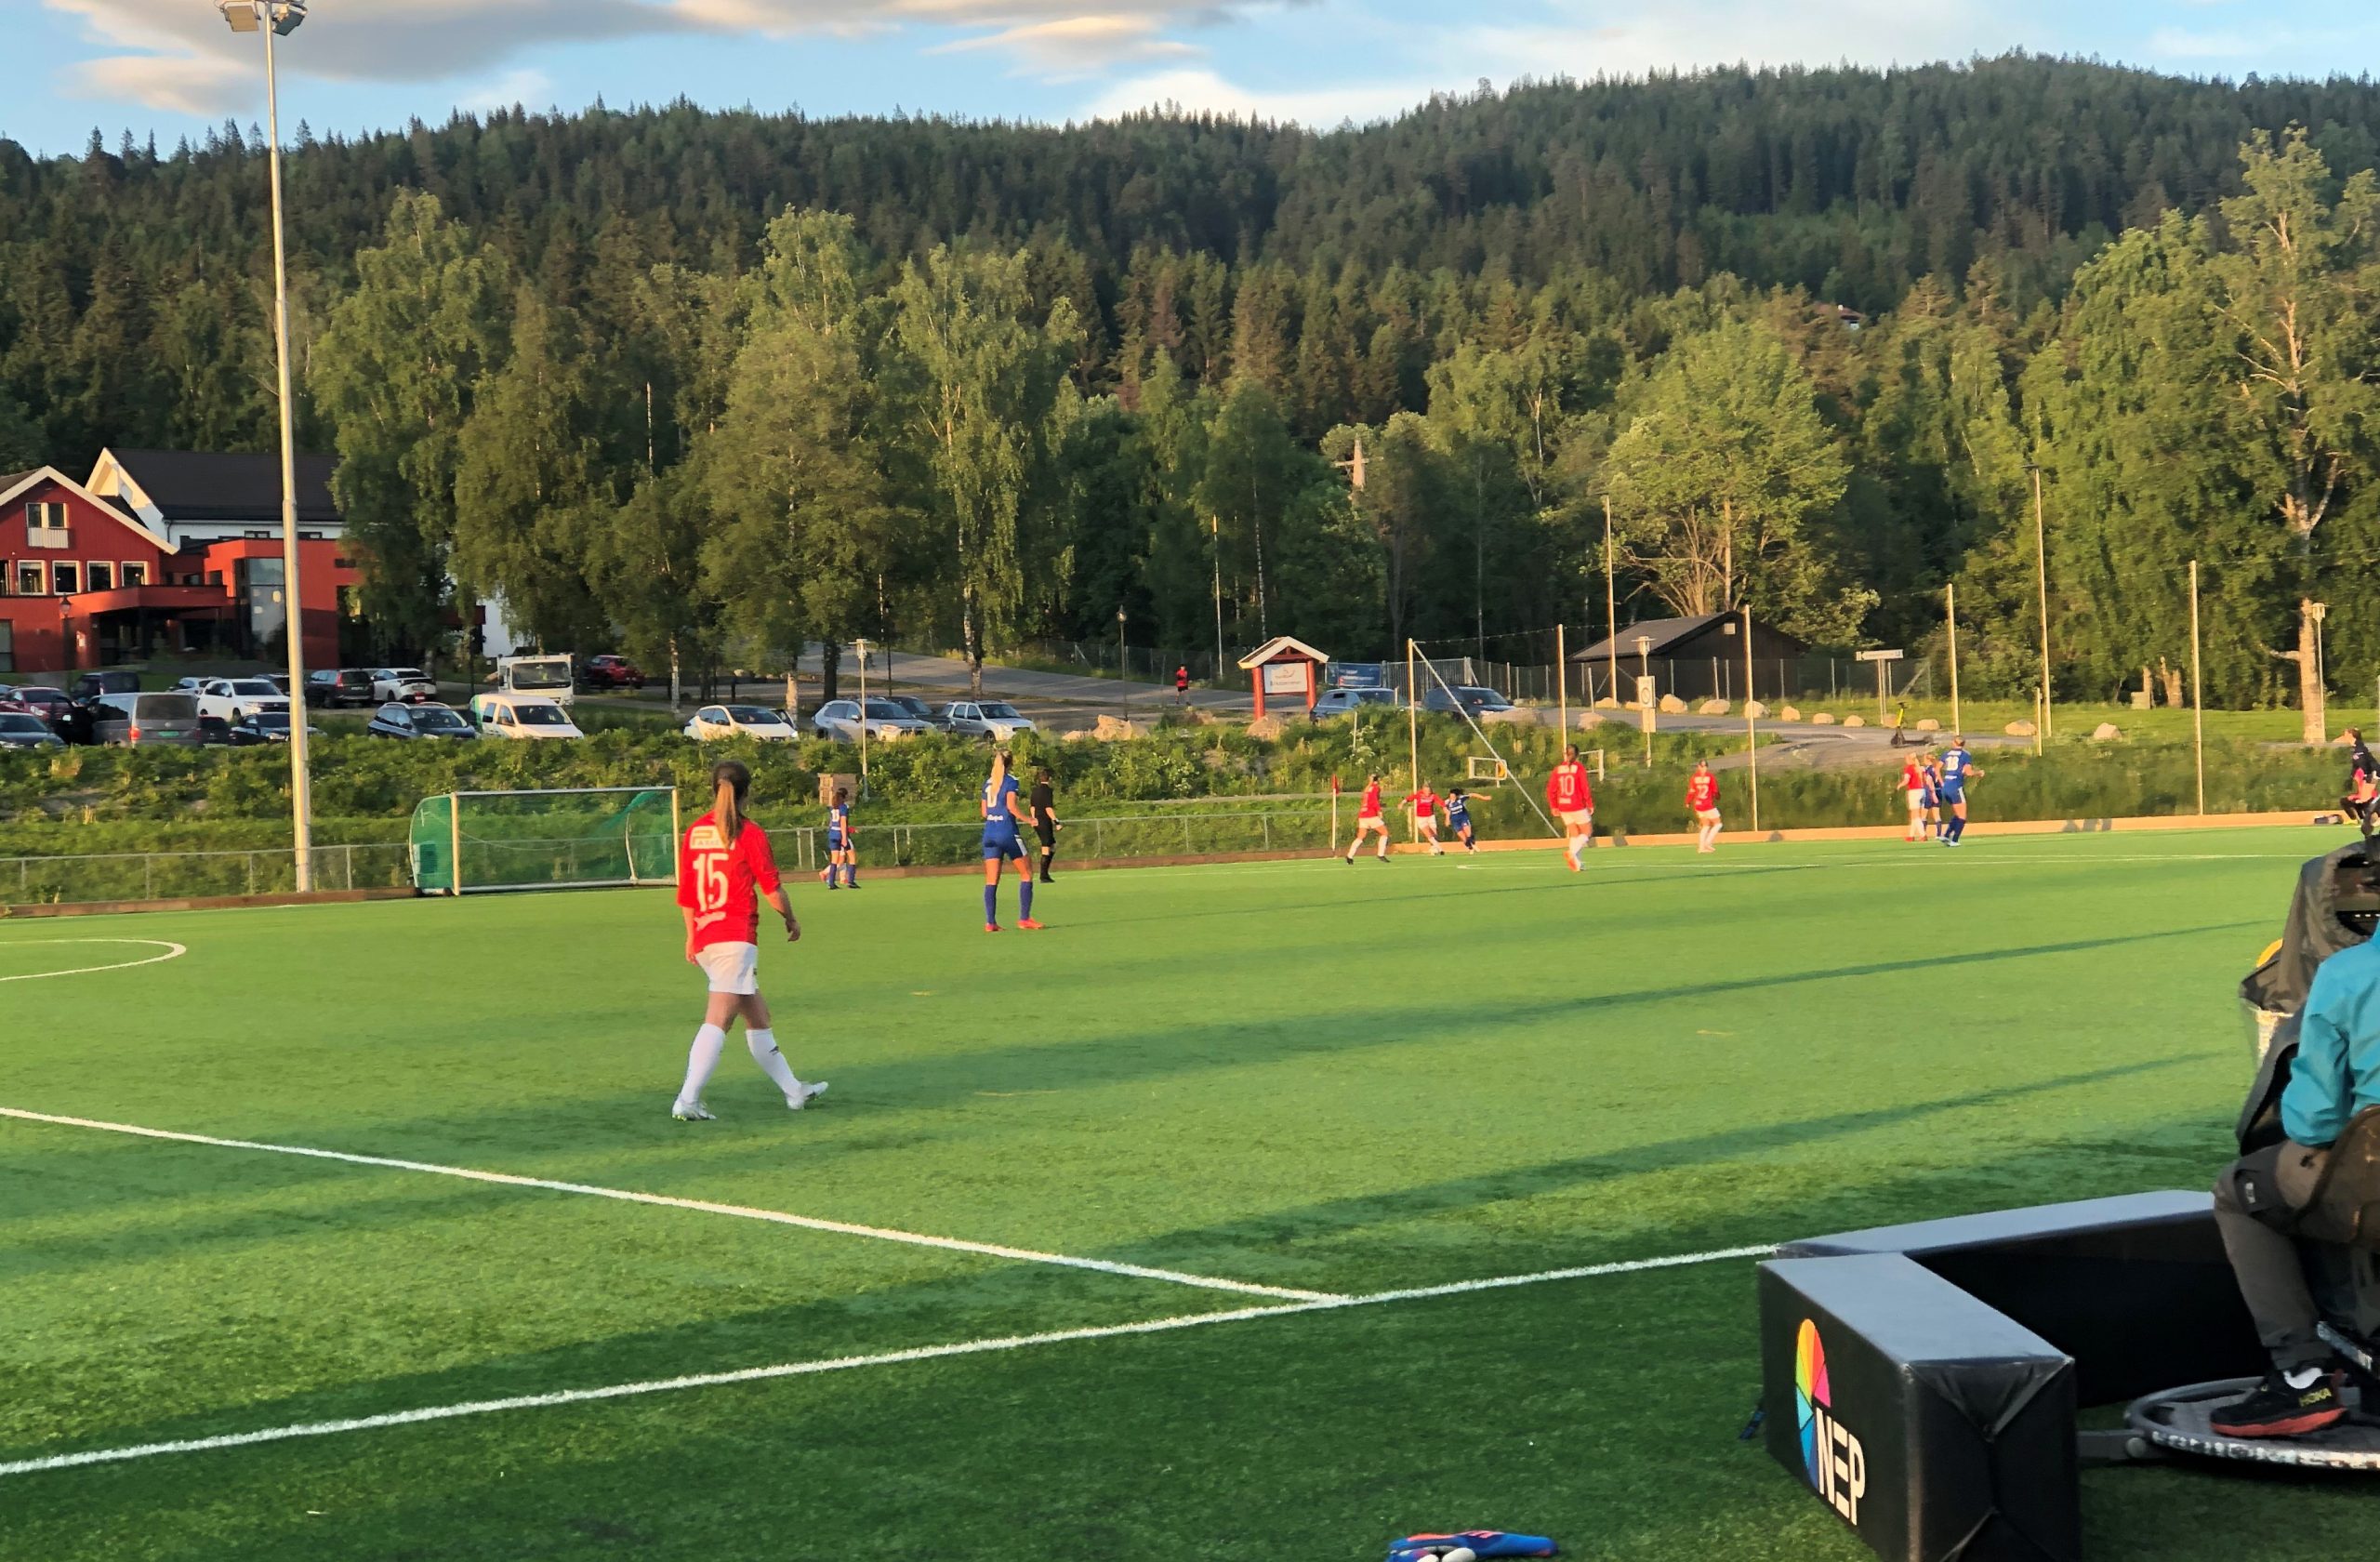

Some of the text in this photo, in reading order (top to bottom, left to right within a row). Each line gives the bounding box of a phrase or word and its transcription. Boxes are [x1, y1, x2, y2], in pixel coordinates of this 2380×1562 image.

[1558, 774, 1575, 797] 10
[692, 853, 729, 912] 15
[2298, 1387, 2332, 1408] HOKA
[1816, 1407, 1866, 1526] NEP
